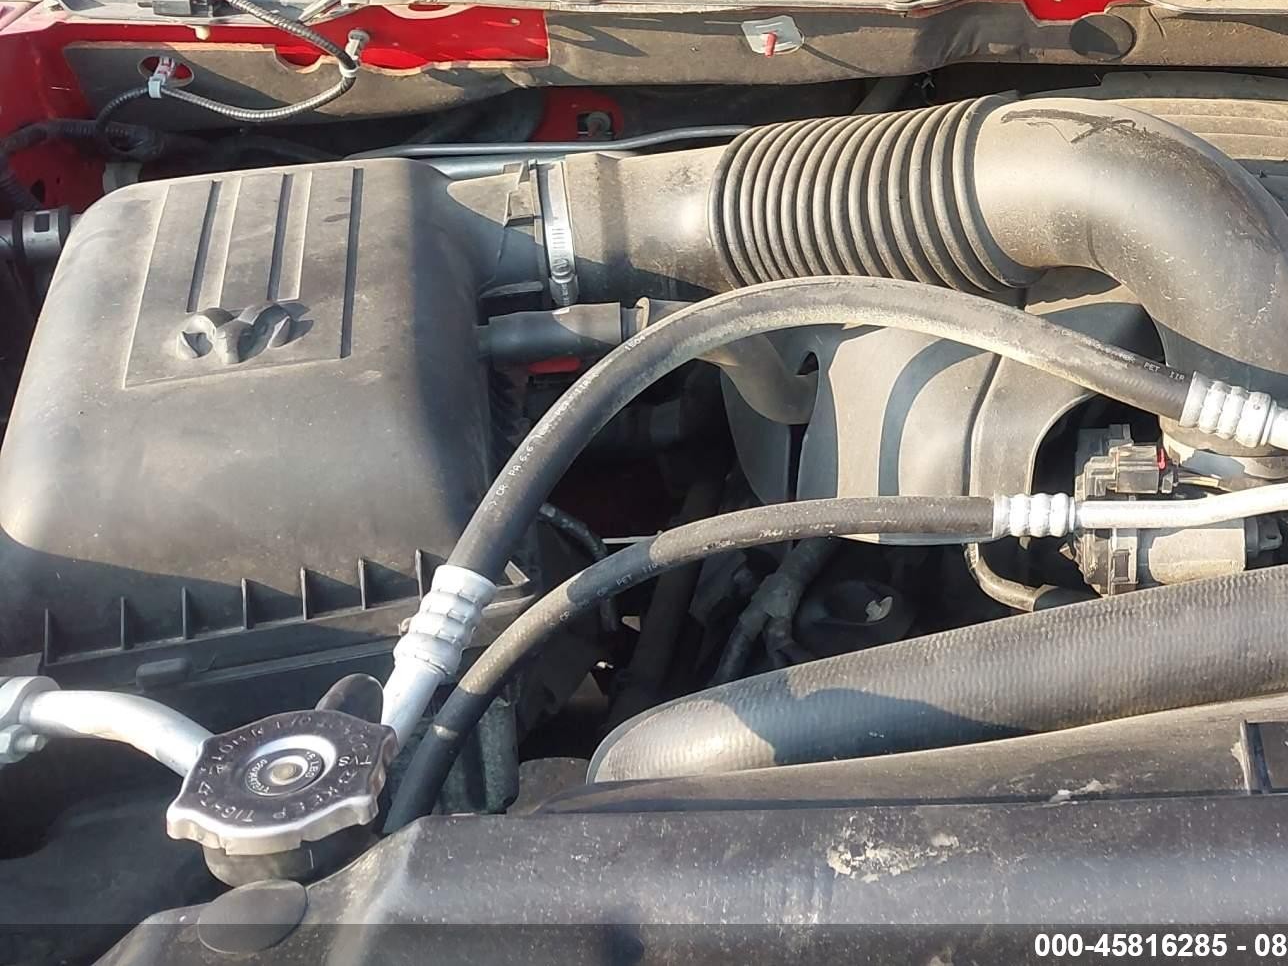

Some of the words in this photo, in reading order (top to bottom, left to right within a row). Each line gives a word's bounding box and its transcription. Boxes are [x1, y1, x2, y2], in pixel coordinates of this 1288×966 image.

[1143, 360, 1161, 373] PET
[1168, 370, 1186, 382] IIR
[519, 445, 534, 462] 6.6
